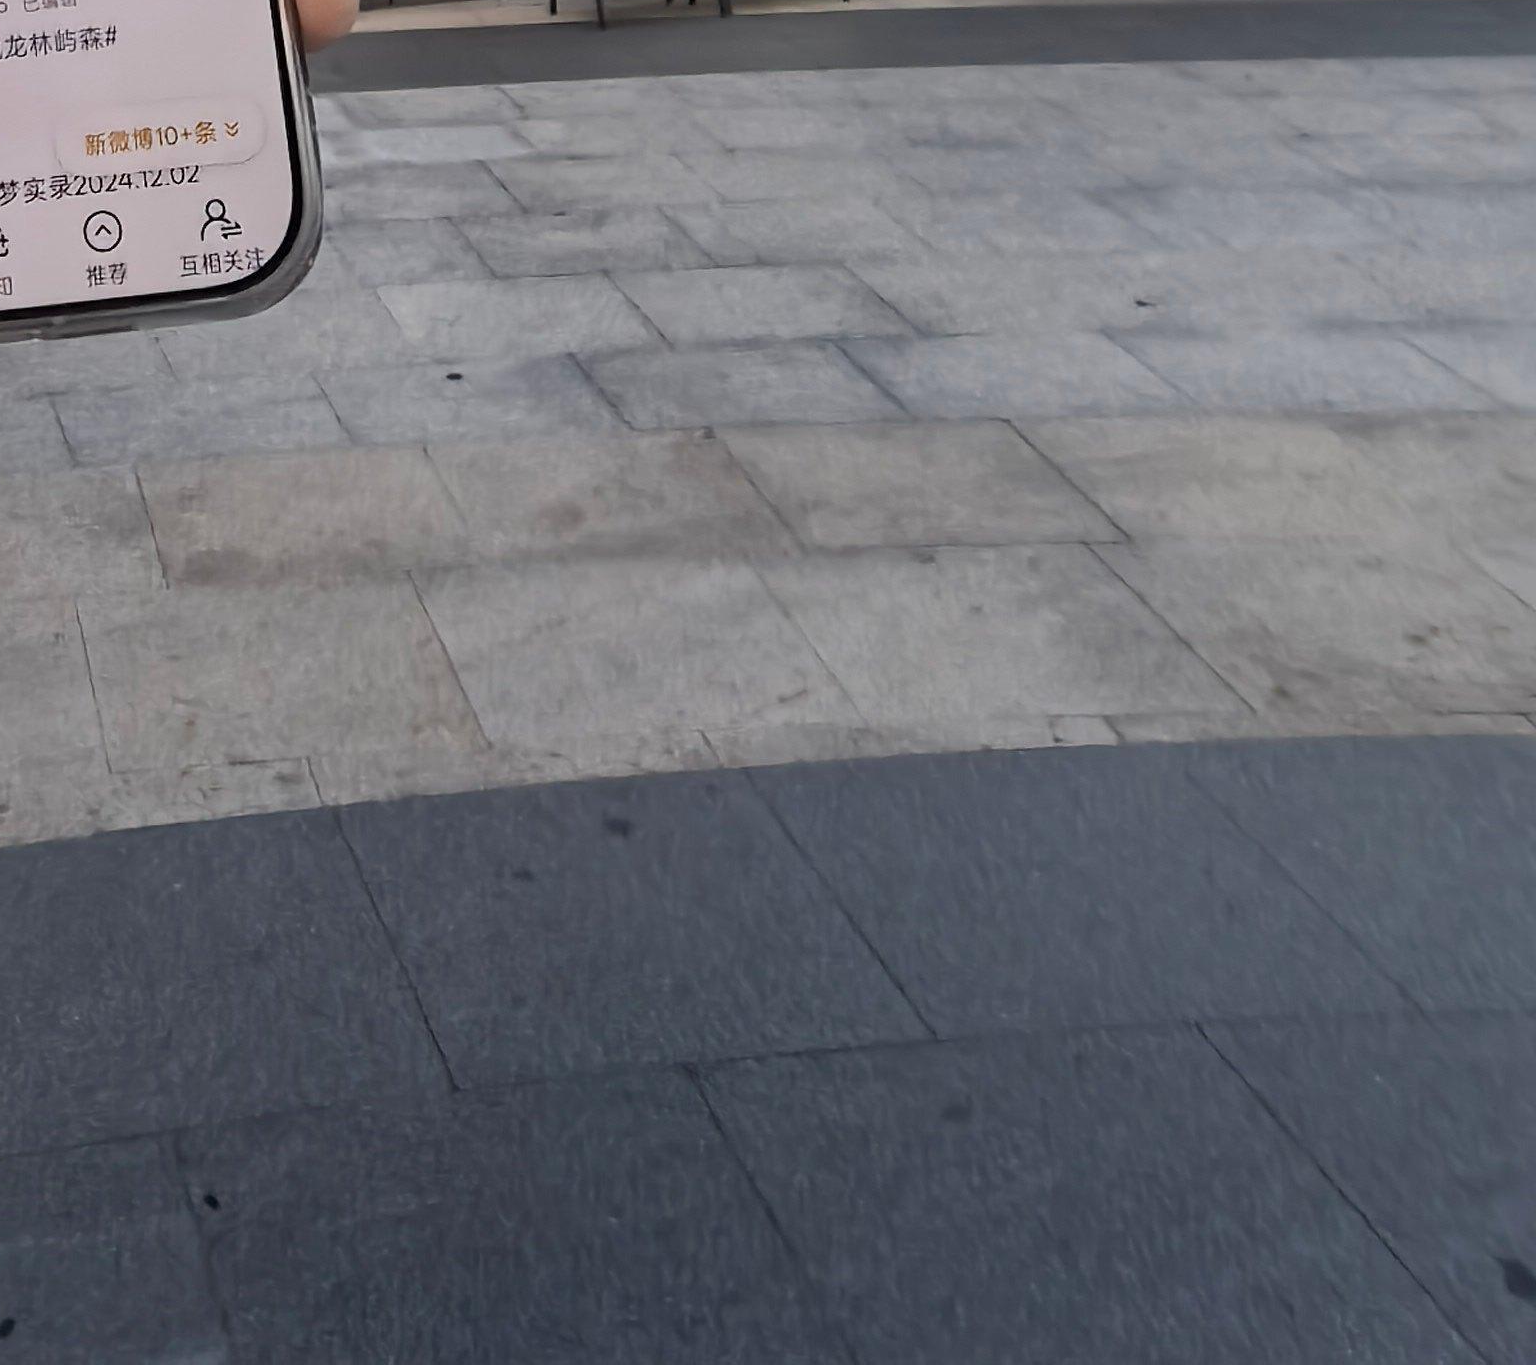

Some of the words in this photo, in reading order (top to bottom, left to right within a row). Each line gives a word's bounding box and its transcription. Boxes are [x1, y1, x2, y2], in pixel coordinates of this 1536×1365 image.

[86, 263, 128, 288] 推荐
[180, 247, 266, 278] 互相关注
